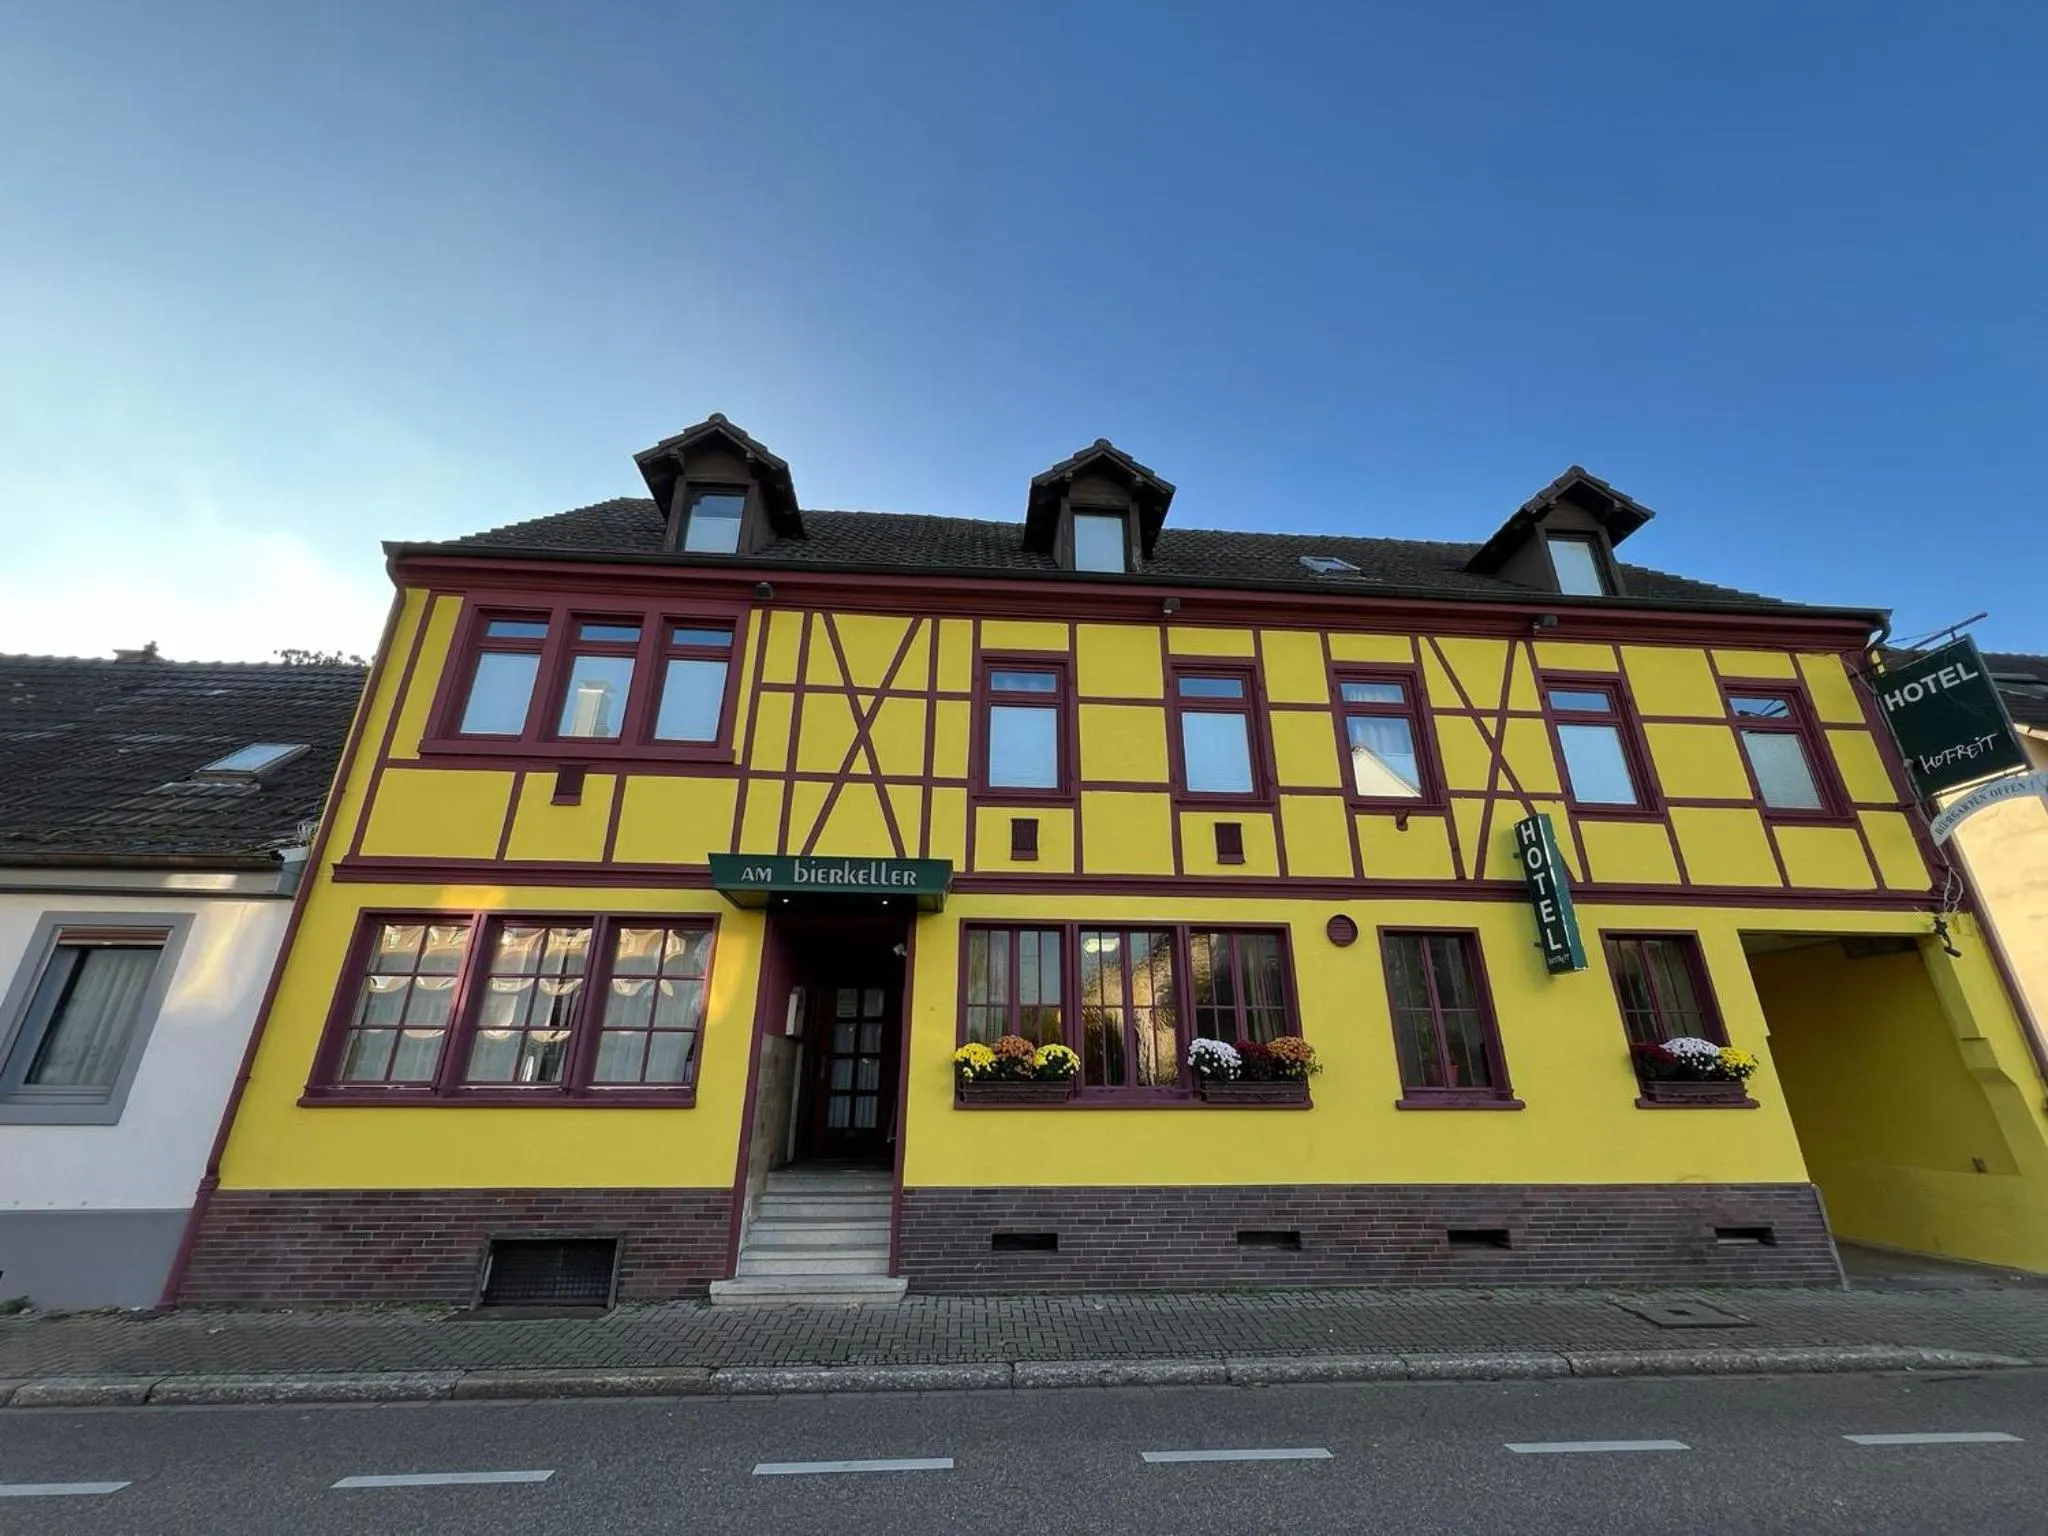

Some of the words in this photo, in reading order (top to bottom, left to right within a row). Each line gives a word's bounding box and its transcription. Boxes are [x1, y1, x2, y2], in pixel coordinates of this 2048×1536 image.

[1884, 662, 1979, 712] HOTEL
[1934, 792, 1988, 836] BIERGARTEN
[1990, 782, 2026, 798] OFFEN
[741, 866, 772, 883] AM
[1520, 821, 1562, 950] HOTEL
